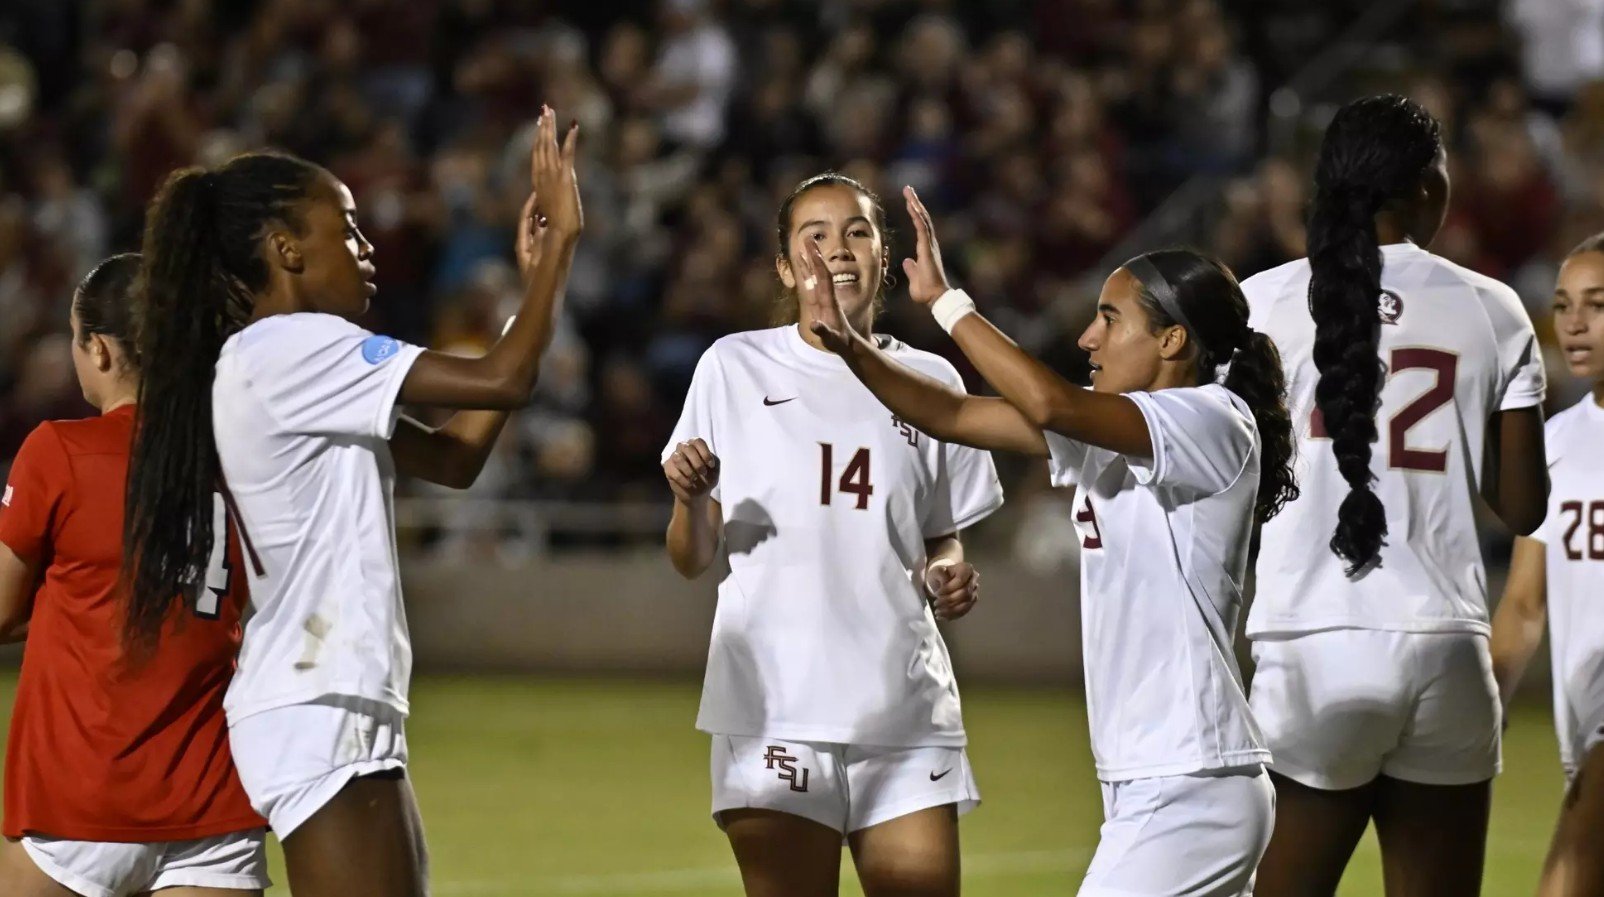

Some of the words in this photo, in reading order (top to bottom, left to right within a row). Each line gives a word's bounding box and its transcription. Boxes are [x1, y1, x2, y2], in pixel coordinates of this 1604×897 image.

[1308, 344, 1460, 475] 2
[815, 441, 875, 511] 14
[1559, 500, 1604, 561] 28
[763, 745, 810, 793] FSU
